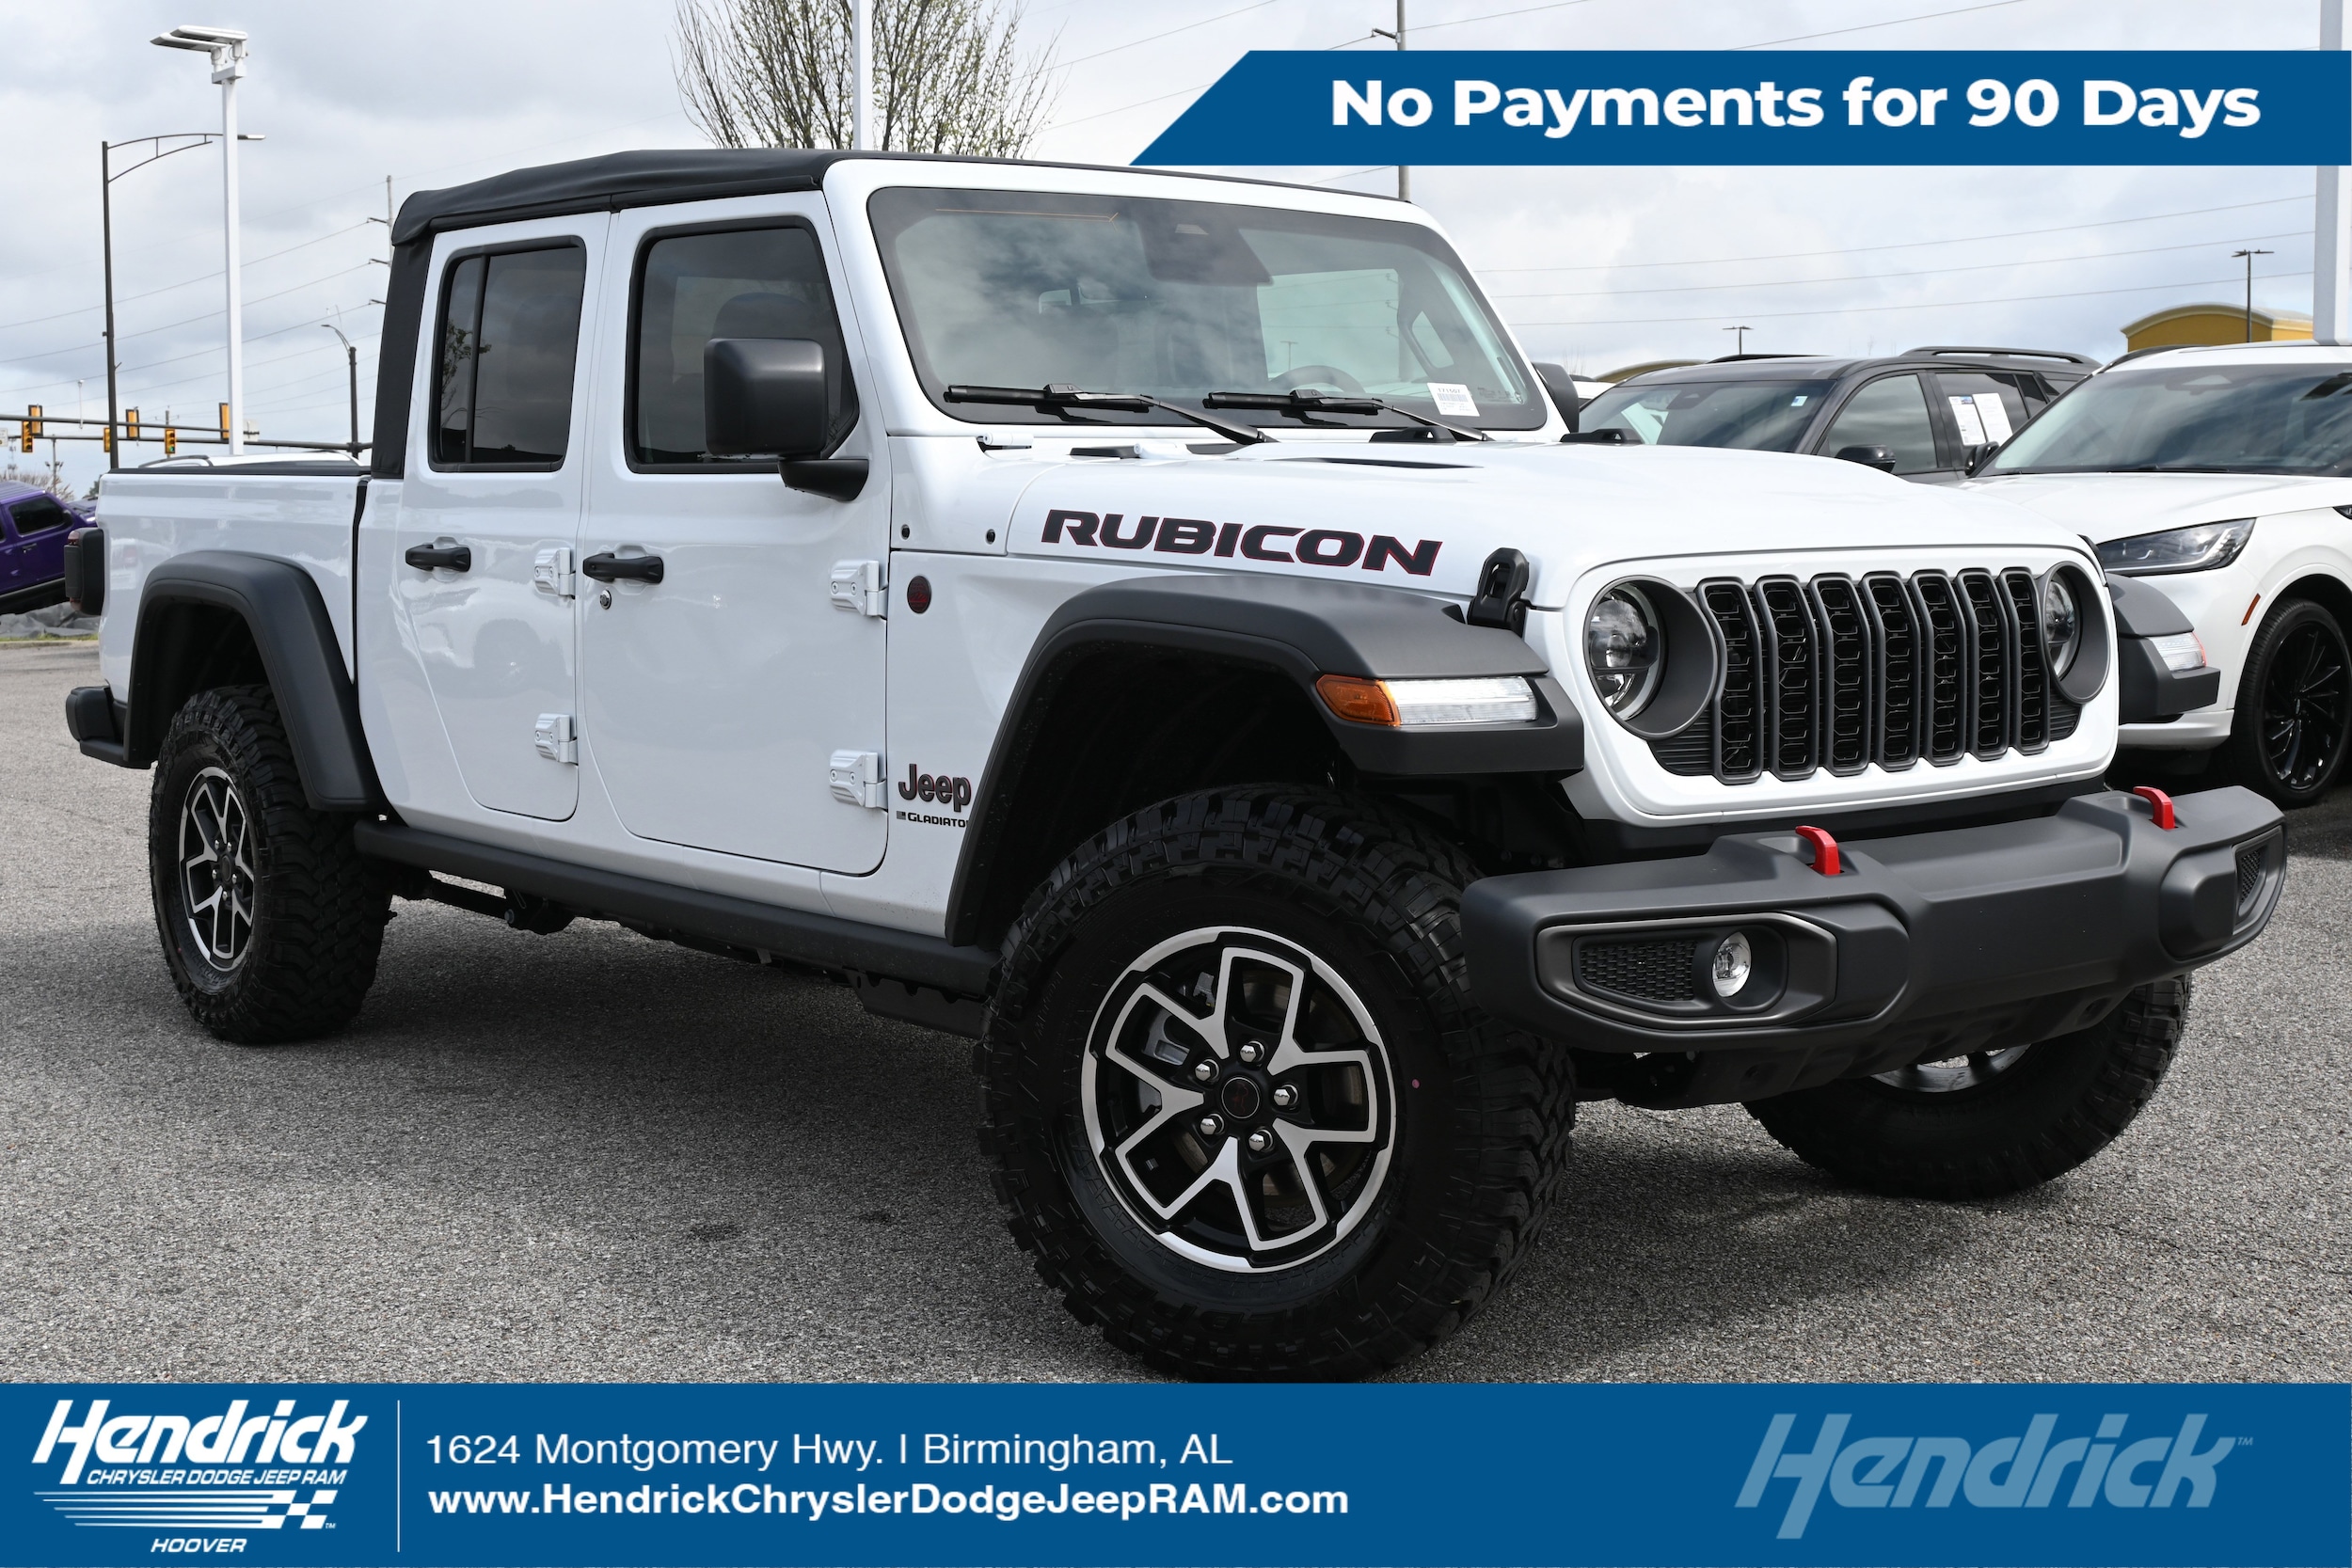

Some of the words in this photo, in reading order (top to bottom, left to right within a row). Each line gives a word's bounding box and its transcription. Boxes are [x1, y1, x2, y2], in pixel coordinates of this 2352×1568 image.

[1041, 509, 1443, 577] RUBICON
[898, 763, 972, 814] Jeep
[907, 812, 969, 828] GLADIATO
